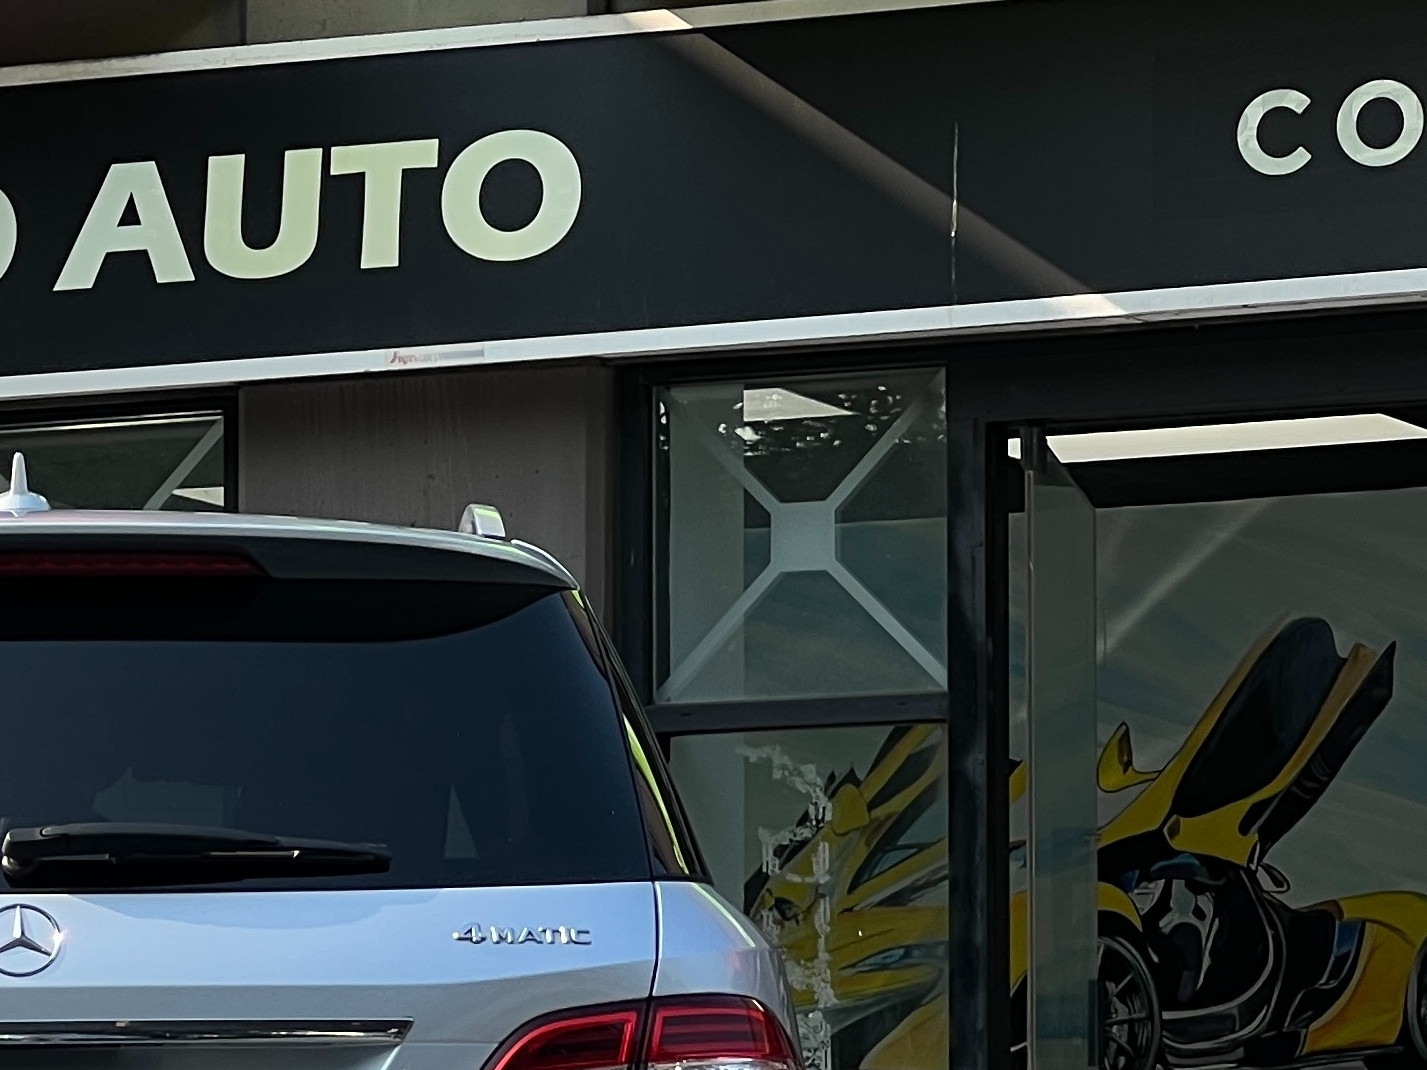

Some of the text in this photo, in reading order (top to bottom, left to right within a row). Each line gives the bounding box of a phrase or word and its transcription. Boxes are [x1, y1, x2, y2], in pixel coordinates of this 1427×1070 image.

[1236, 79, 1426, 176] CO
[52, 129, 583, 292] AUTO
[451, 921, 593, 946] 4MATIC
